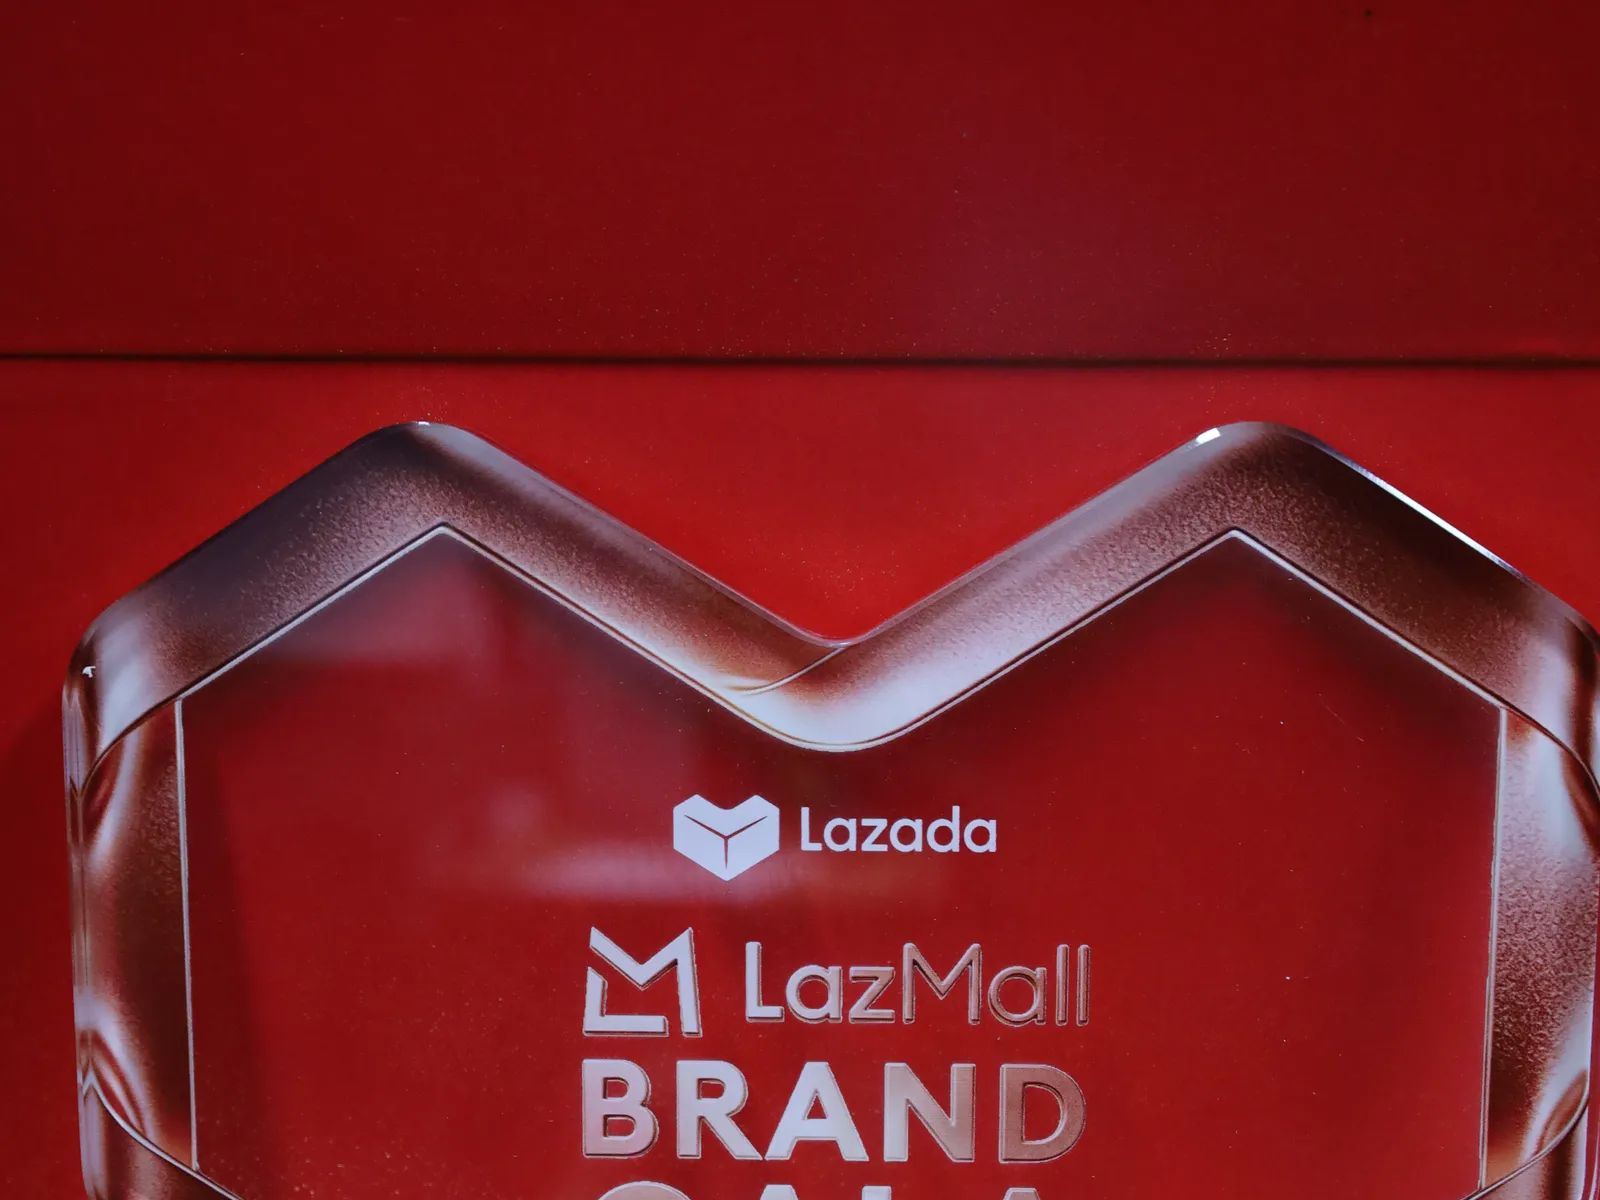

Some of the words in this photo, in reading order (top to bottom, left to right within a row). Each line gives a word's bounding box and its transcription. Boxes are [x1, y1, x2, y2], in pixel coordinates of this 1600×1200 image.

[801, 805, 997, 852] Lazada
[745, 942, 1091, 1025] LazMall
[582, 1058, 1086, 1163] BRAND
